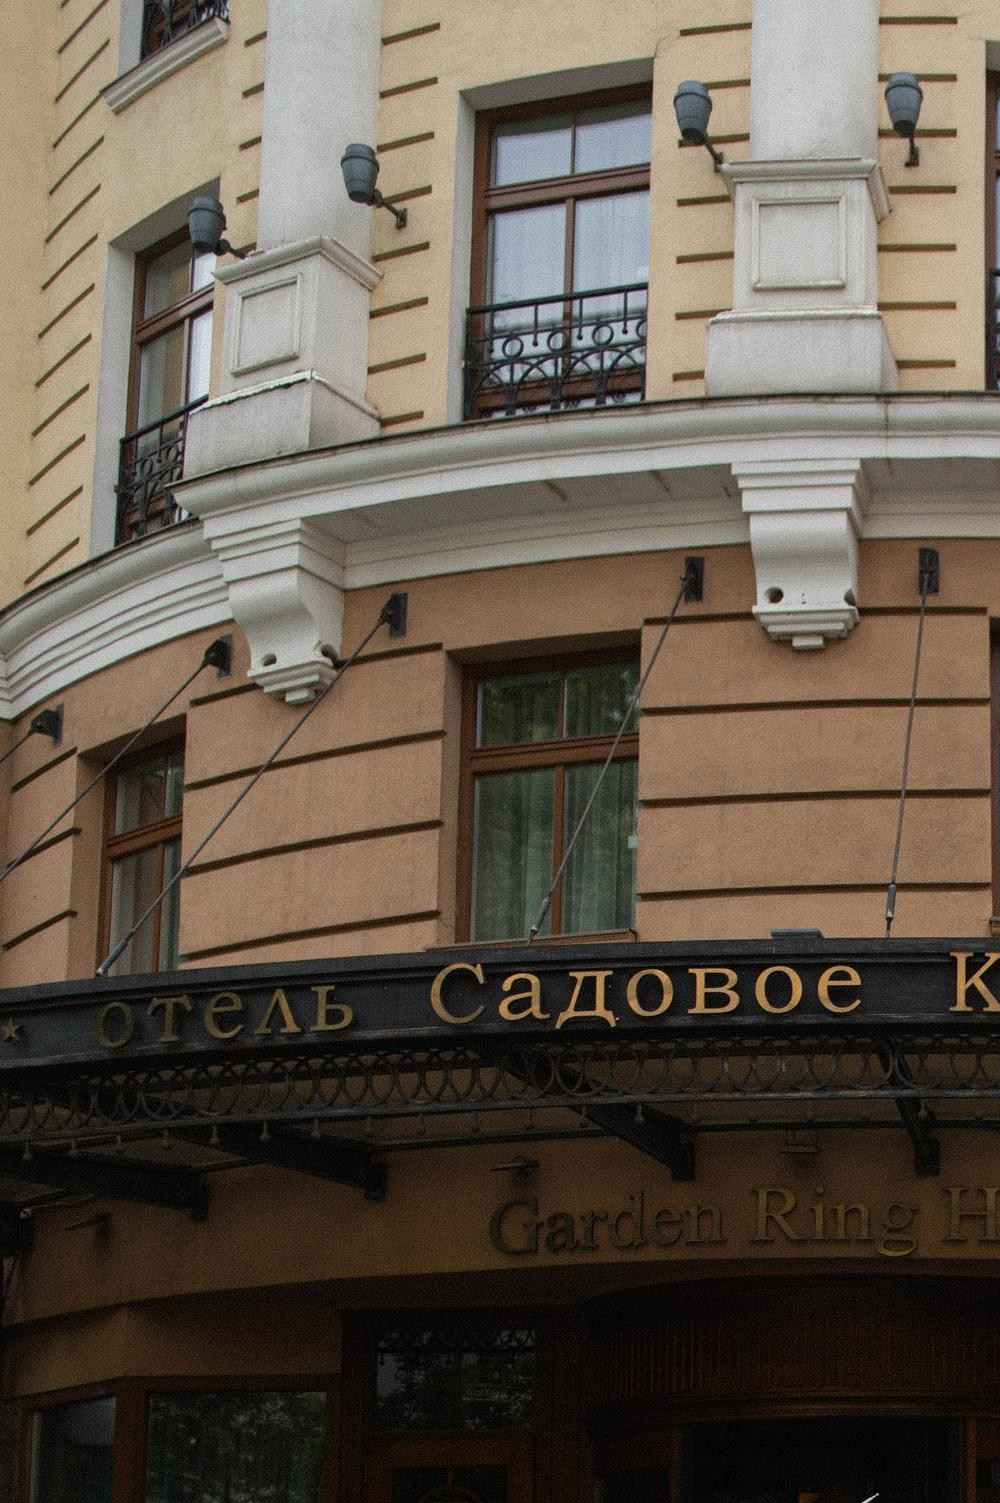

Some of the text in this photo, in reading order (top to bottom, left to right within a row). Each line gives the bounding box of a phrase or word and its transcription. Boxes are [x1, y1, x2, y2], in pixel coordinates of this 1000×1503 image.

[96, 984, 356, 1050] отель
[429, 962, 863, 1029] Садовое
[489, 1193, 727, 1254] Garden
[753, 1187, 917, 1257] Ring
